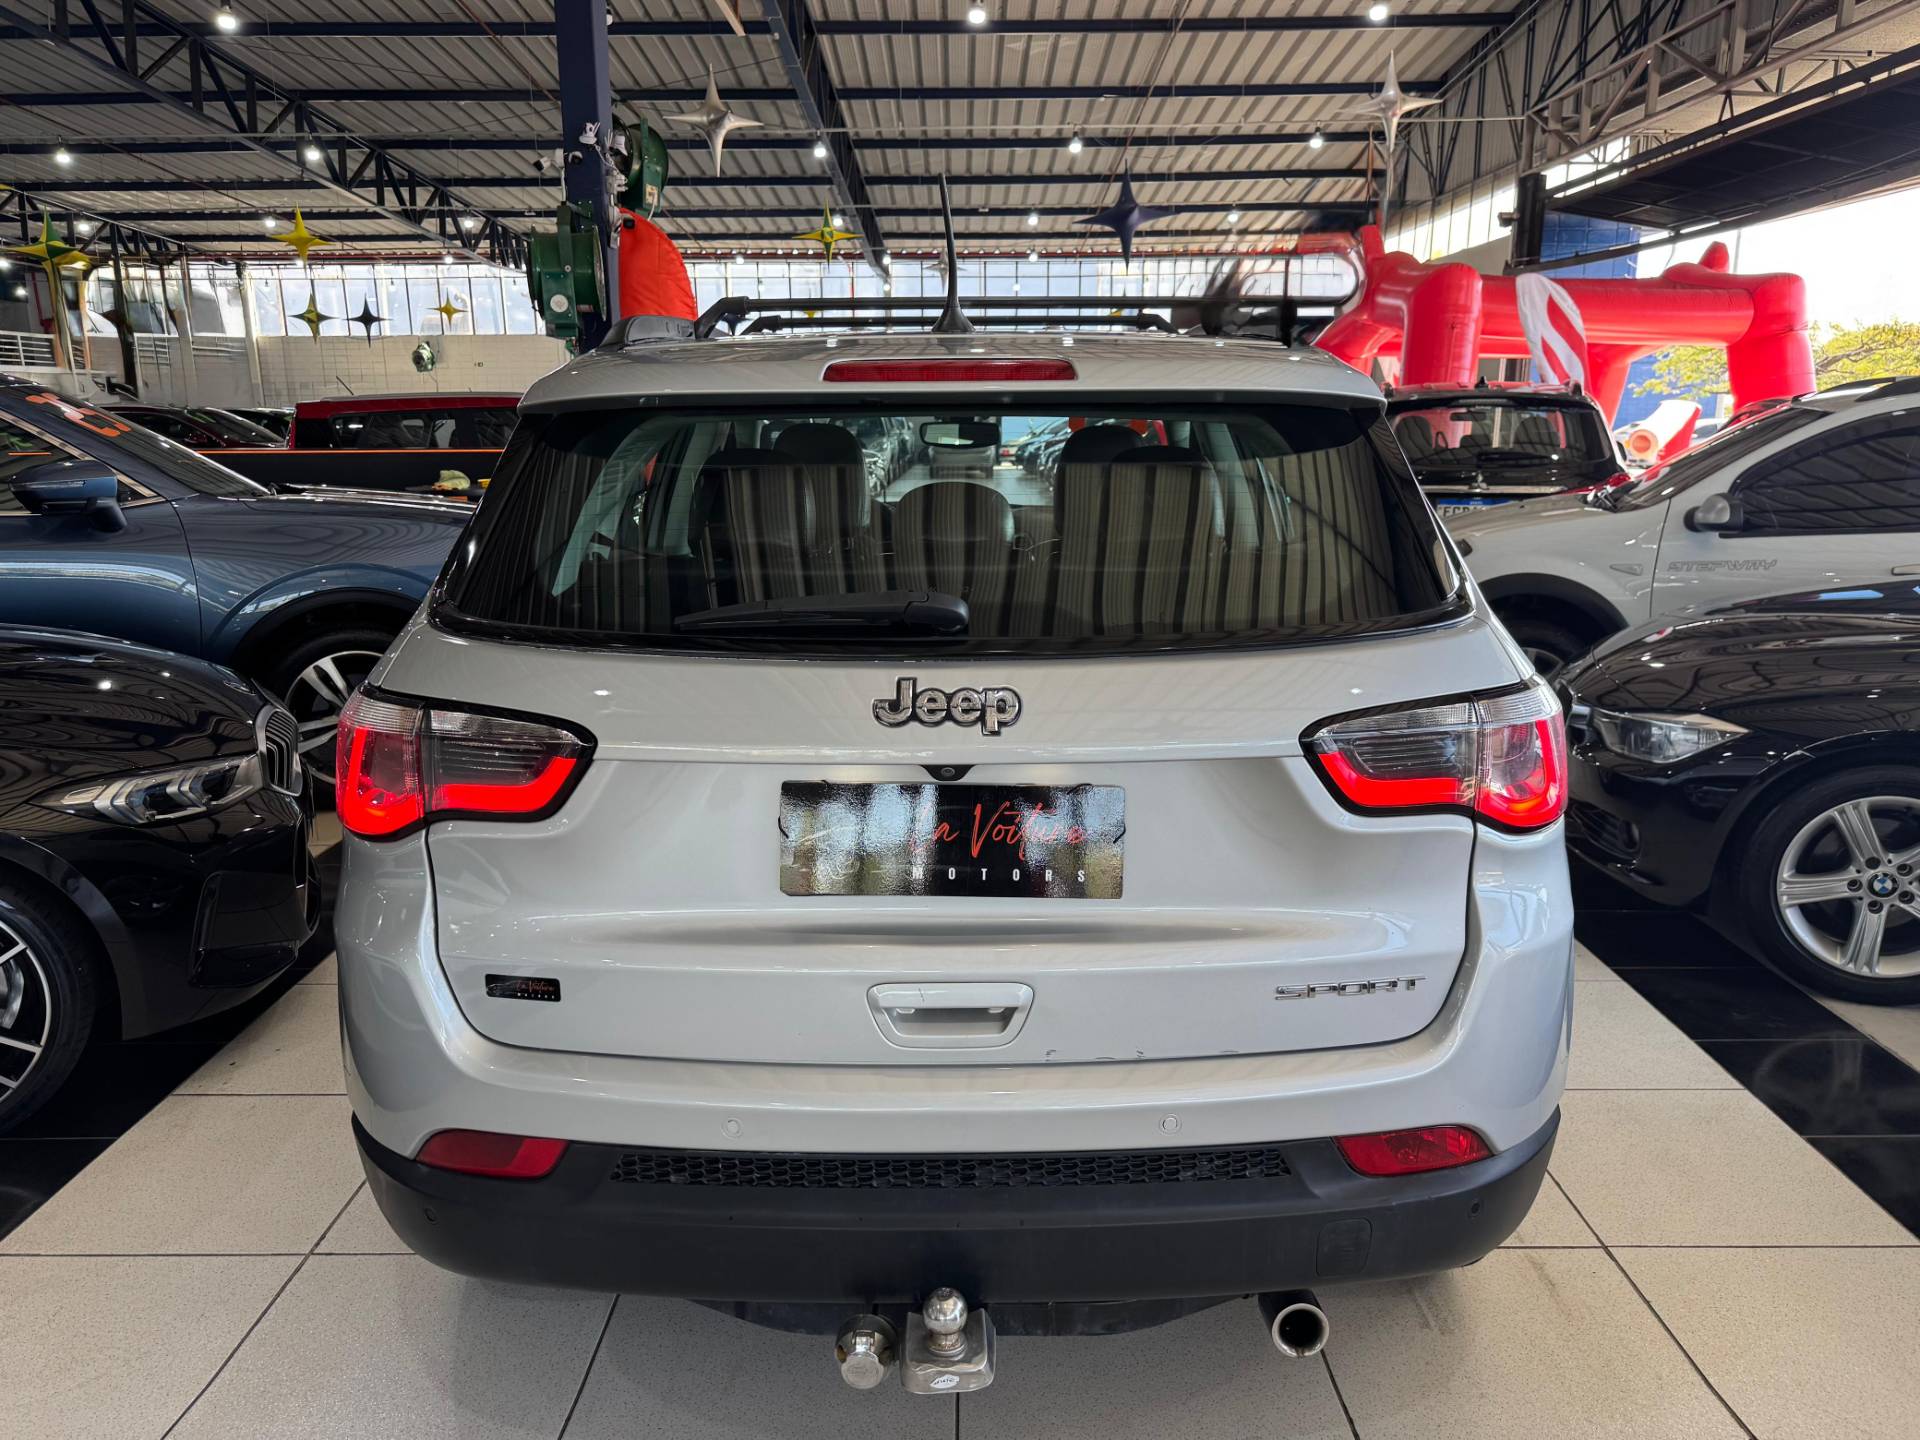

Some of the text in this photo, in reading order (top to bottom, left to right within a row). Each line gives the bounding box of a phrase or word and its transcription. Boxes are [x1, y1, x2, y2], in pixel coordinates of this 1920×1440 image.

[1667, 559, 1778, 573] STEPWAY
[872, 676, 1022, 737] Jeep
[970, 800, 1087, 862] Voitue
[912, 866, 1086, 883] MOTORS
[1274, 975, 1428, 1001] SPORT
